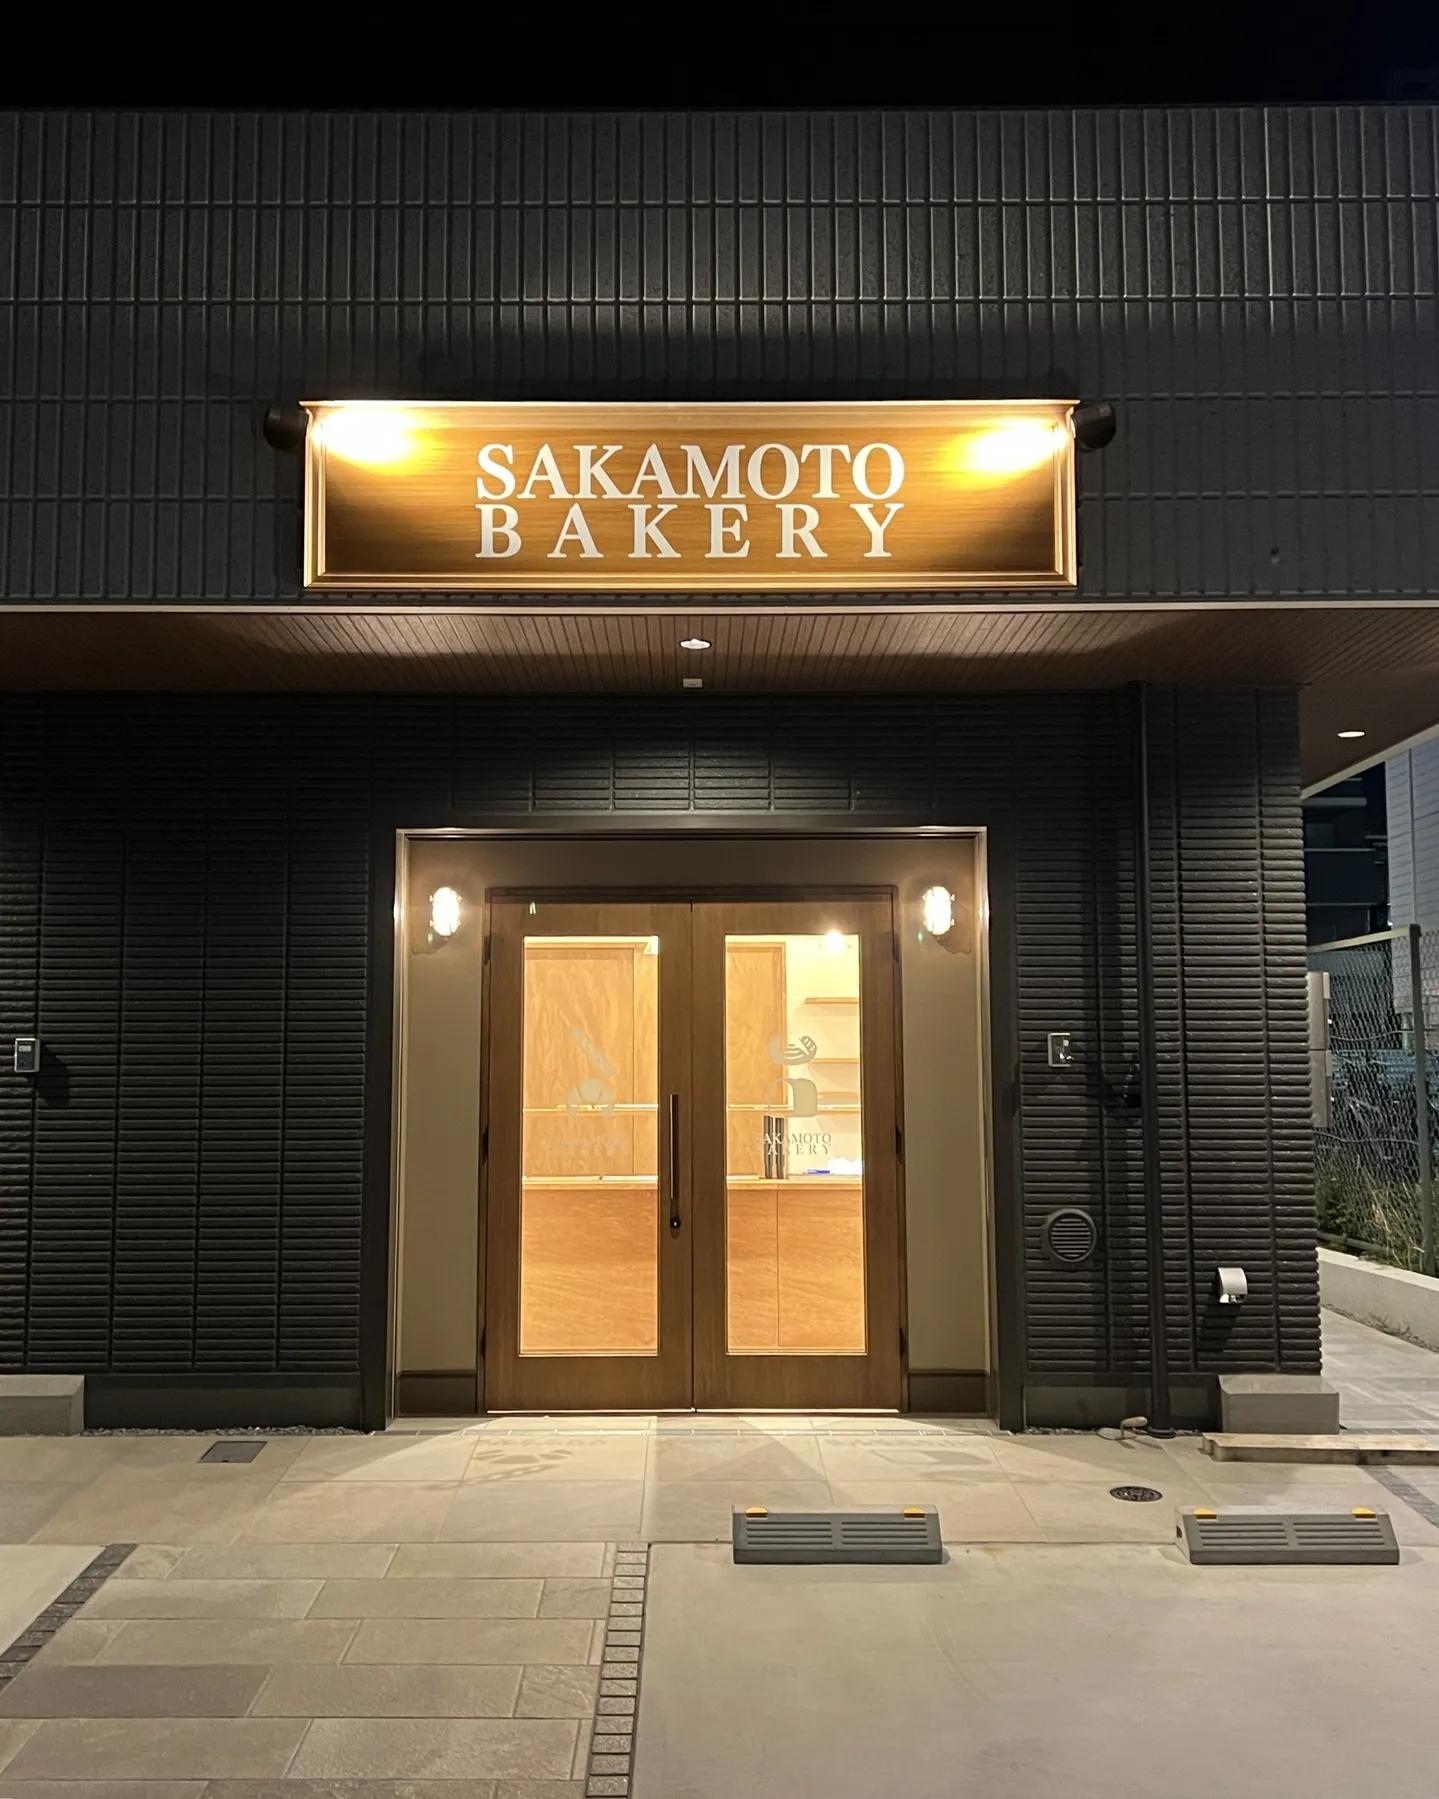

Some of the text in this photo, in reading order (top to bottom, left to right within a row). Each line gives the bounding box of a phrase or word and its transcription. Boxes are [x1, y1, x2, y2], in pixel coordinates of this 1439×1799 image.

[476, 442, 906, 501] SAKAMOTO
[475, 502, 905, 559] BAKERY
[756, 1132, 832, 1144] AKAMOTO
